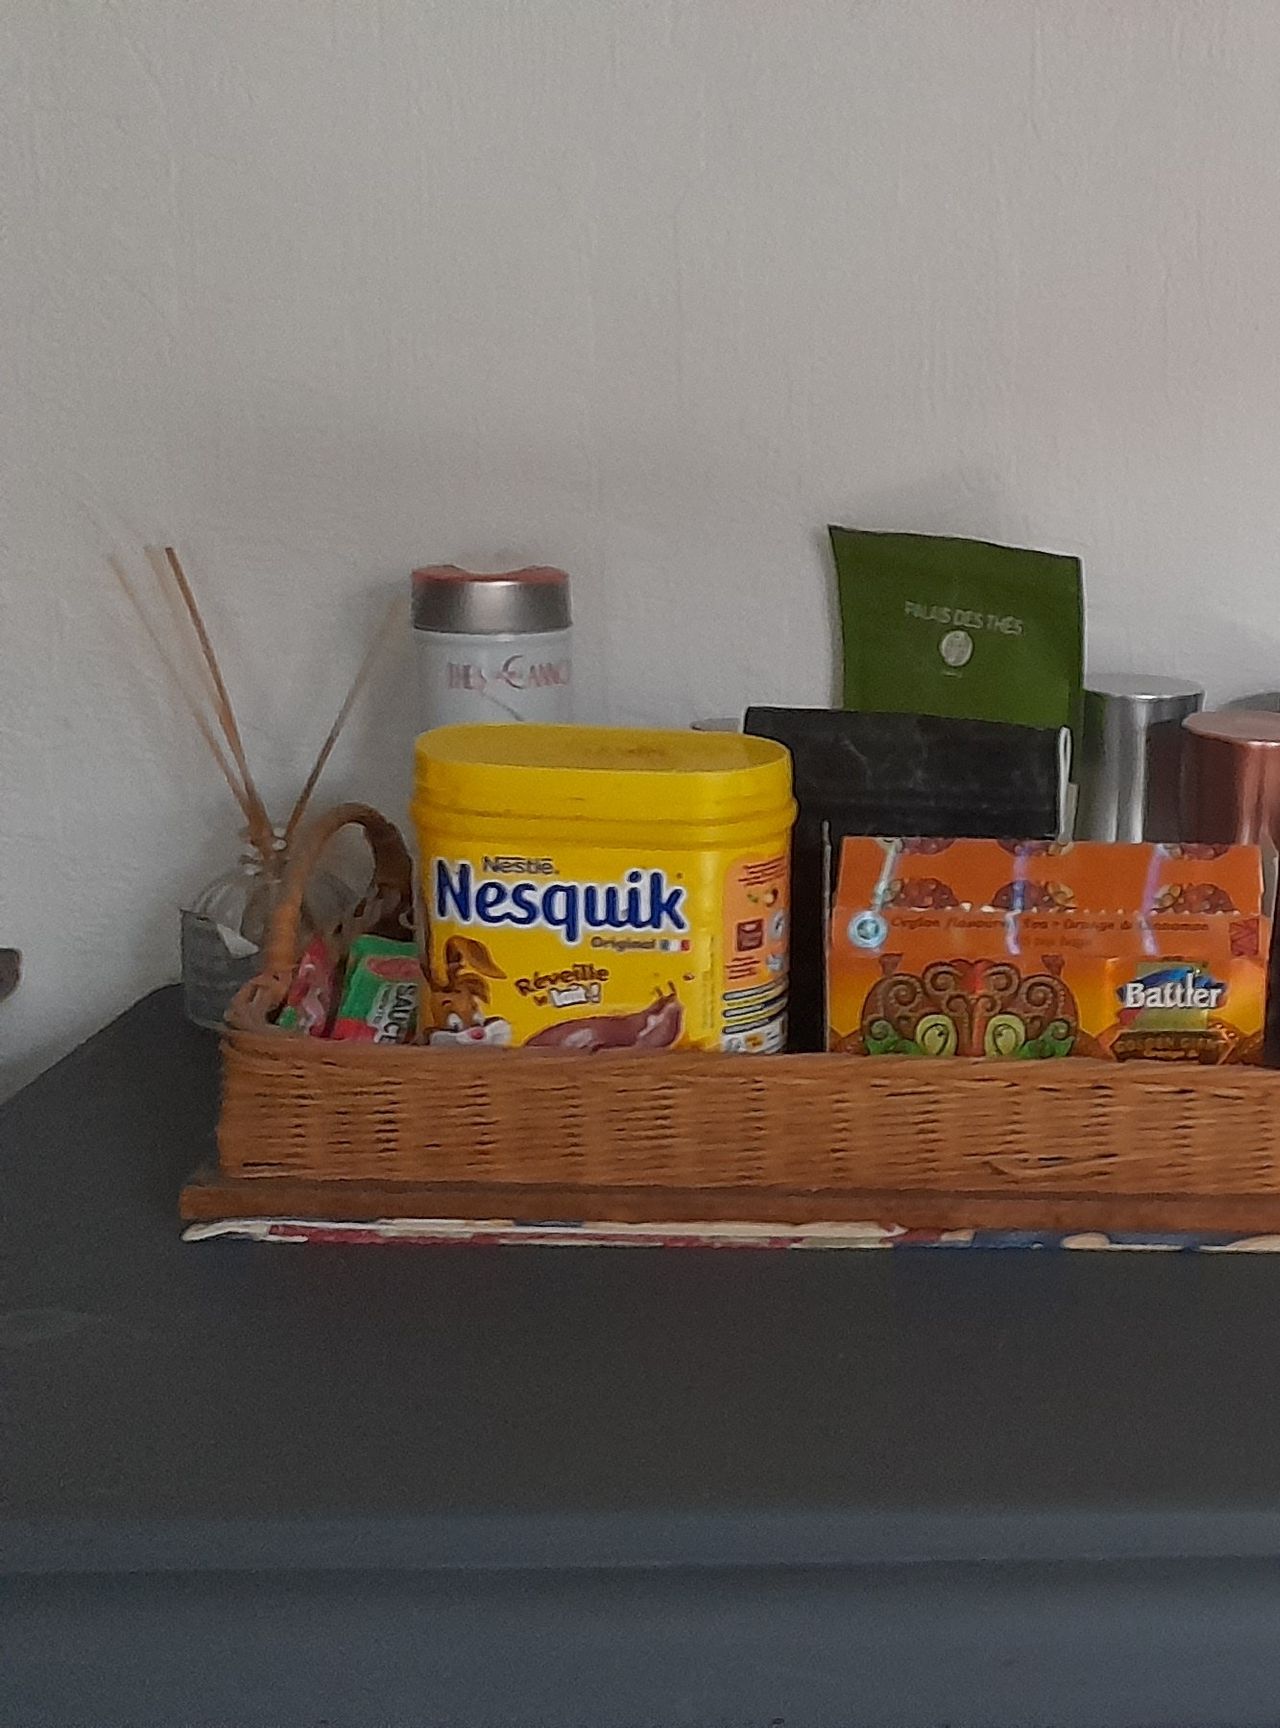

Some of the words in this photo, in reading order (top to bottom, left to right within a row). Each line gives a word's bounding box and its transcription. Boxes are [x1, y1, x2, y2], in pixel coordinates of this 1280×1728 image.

[953, 608, 984, 629] DES
[435, 858, 687, 943] Nesquik
[590, 935, 657, 952] Original
[514, 963, 610, 997] Réveille
[1125, 972, 1222, 1008] Battler
